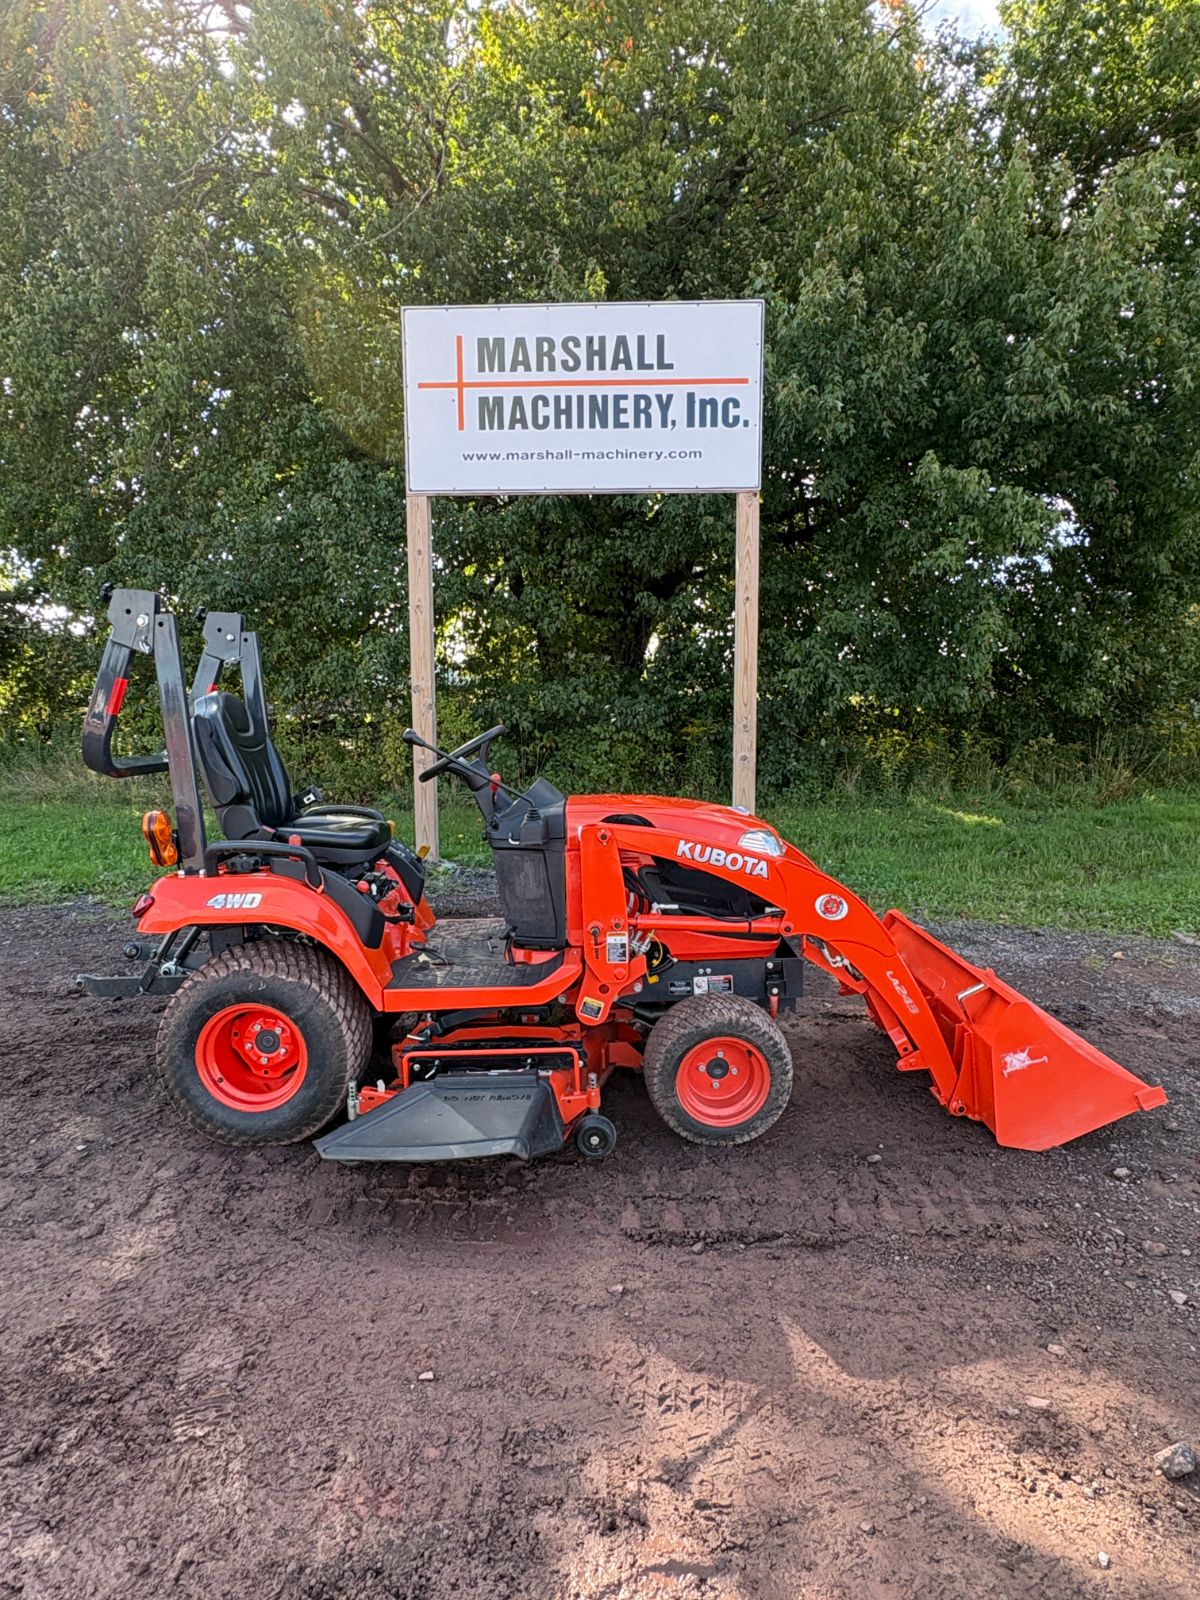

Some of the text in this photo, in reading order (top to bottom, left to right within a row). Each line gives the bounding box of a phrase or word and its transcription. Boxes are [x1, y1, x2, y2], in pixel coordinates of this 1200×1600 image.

[476, 334, 674, 373] MARSHALL
[477, 391, 750, 432] MACHINERY, Inc.
[462, 448, 703, 462] www.marshall-machinery.com
[676, 839, 769, 879] KUBOTA
[205, 892, 263, 910] 4WD
